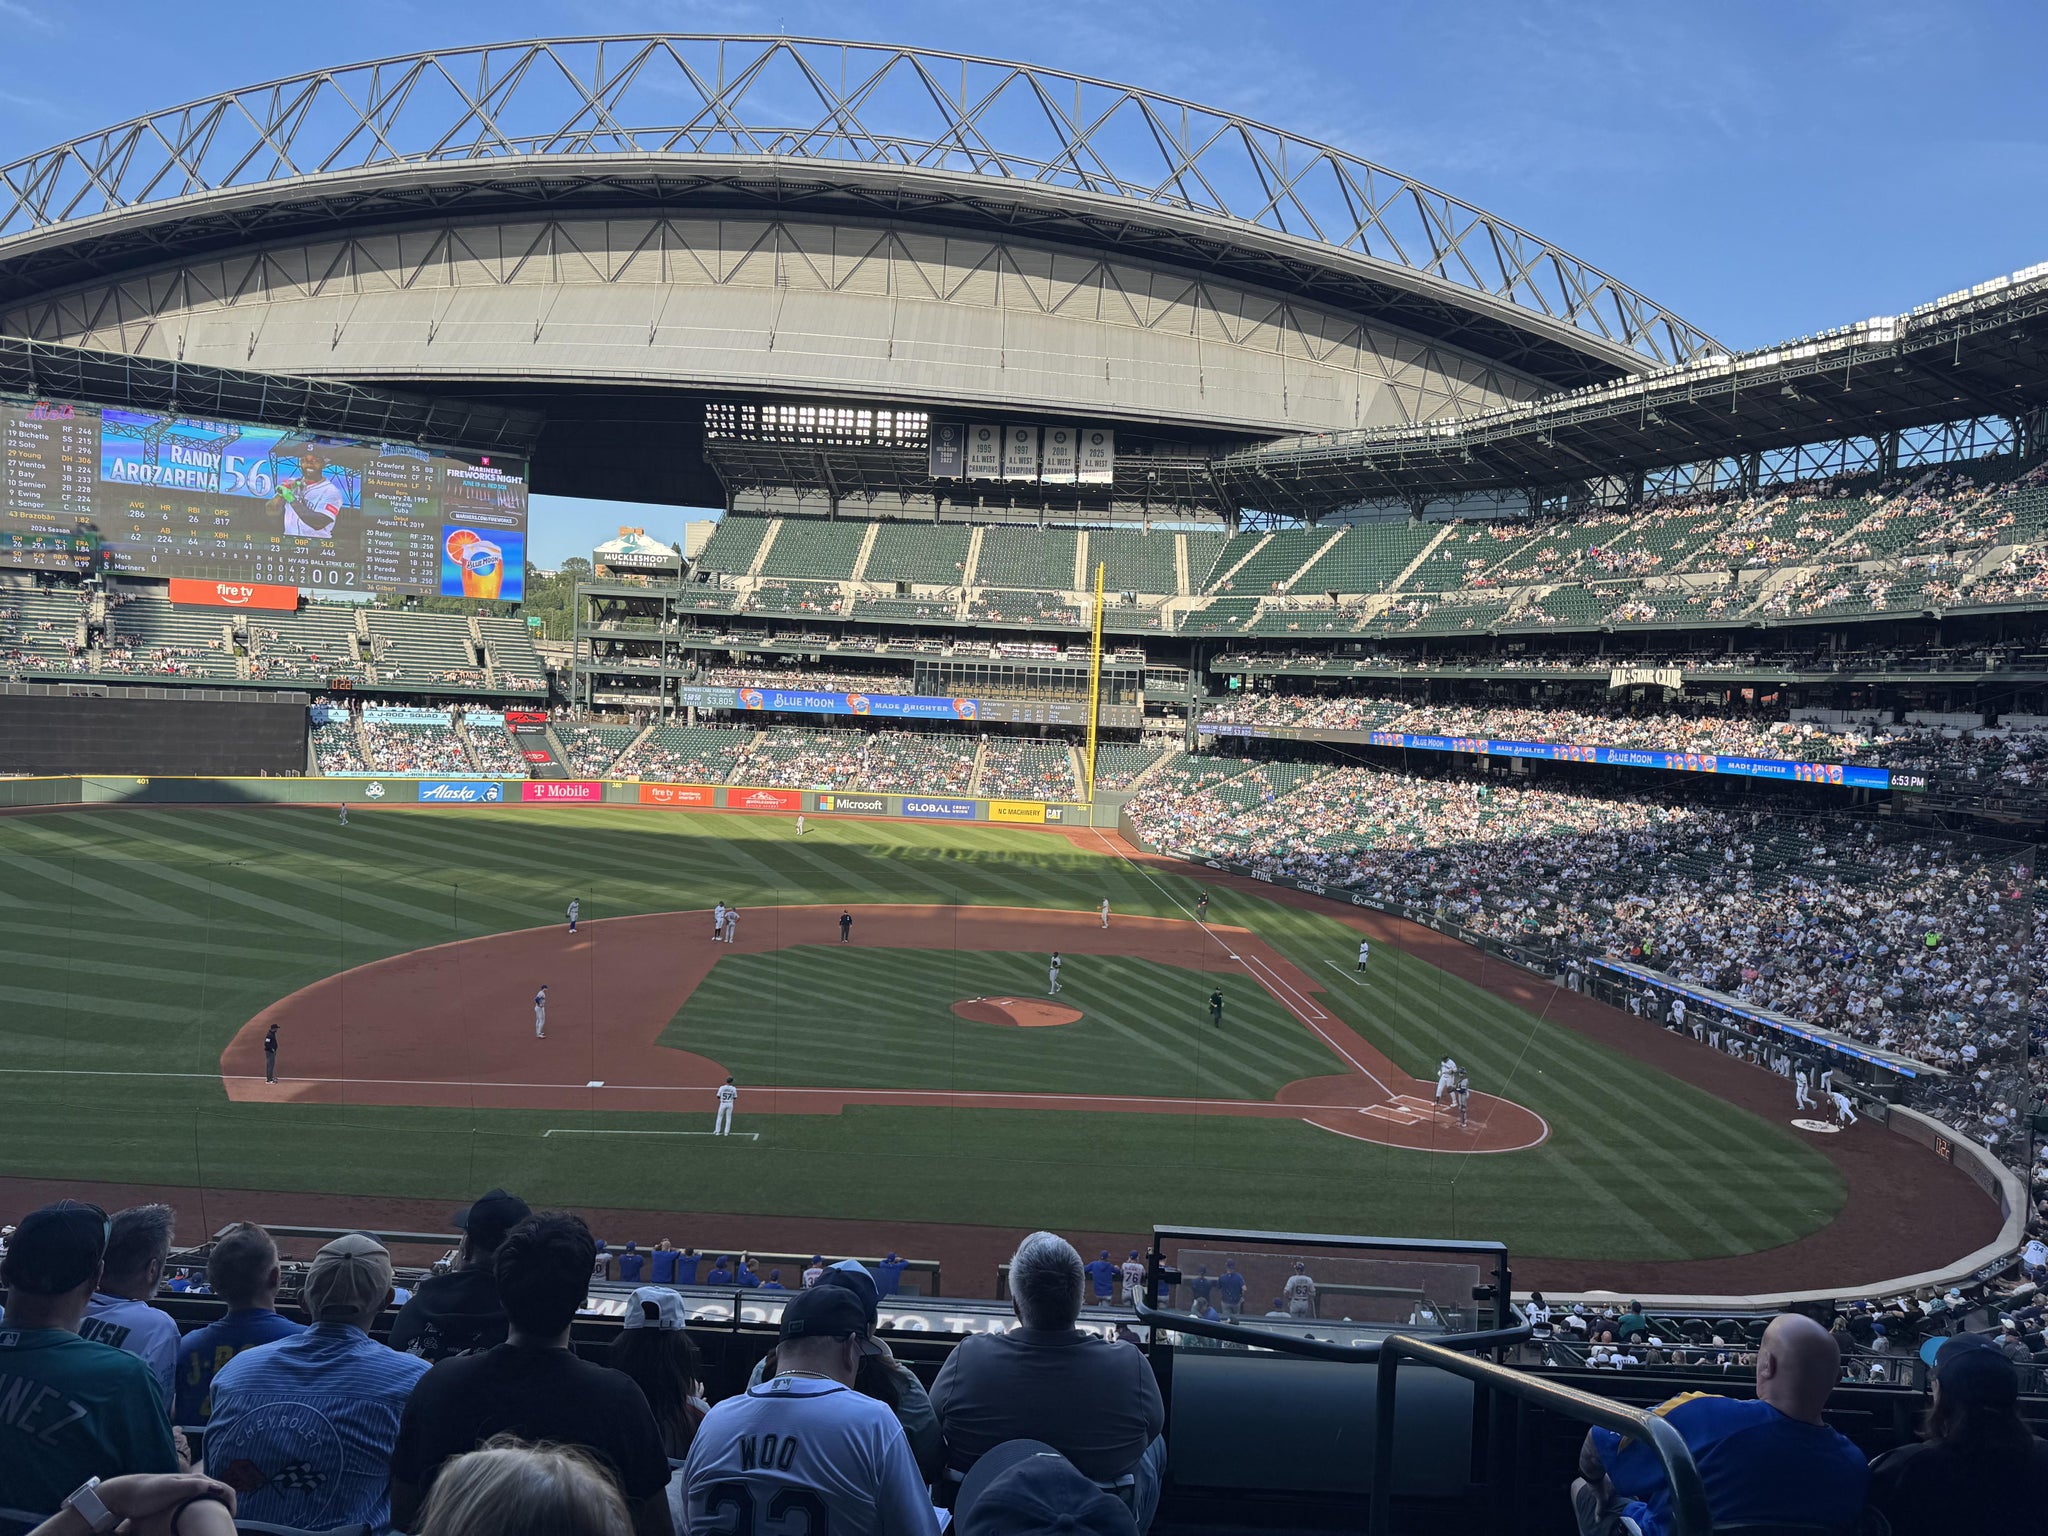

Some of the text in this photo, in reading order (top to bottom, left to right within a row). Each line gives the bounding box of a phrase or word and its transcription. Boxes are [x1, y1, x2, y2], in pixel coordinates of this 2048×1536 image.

[19, 421, 43, 430] Benge
[19, 431, 49, 440] Bichette
[977, 444, 991, 453] 1995
[1014, 445, 1028, 454] 1997
[1052, 447, 1067, 456] 2001
[1090, 448, 1105, 457] 2025
[18, 450, 42, 460] Young
[76, 456, 92, 464] .306
[171, 445, 221, 471] RANDY
[18, 461, 46, 469] Vientos
[377, 462, 405, 470] Crawford
[468, 465, 502, 475] MARINERS
[969, 465, 998, 474] CHAMPIONS
[1006, 466, 1035, 474] CHAMPIONS
[18, 471, 35, 479] Baty
[111, 458, 218, 493] AROZARENA
[224, 455, 272, 497] 56
[446, 469, 523, 485] FIREWORKS NIGHT
[18, 480, 46, 489] Semien
[18, 490, 41, 499] Ewing
[374, 492, 401, 501] February
[18, 500, 45, 509] Senger
[74, 516, 90, 524] 1.82
[128, 510, 145, 518] .286
[189, 515, 199, 523] 26
[377, 519, 398, 527] August
[157, 535, 172, 543] 224
[216, 540, 226, 548] 23
[271, 544, 281, 552] 23
[375, 539, 393, 547] Young
[115, 553, 157, 563] Mets 0
[466, 555, 499, 570] BLUE MOON
[604, 553, 668, 564] MUCKLESHOOT
[114, 563, 146, 572] Mariners
[312, 569, 355, 585] 0 0 2
[374, 574, 401, 582] Emerson
[217, 584, 253, 597] fire tv
[1610, 669, 1682, 689] ALL STAR CLUB
[773, 693, 834, 709] BLUE MOON
[902, 703, 948, 713] BRIGHTER
[1411, 736, 1444, 748] BLUE MOON
[1607, 749, 1652, 764] BLUE MOON
[1728, 763, 1786, 774] MADE BRIGHTER
[1891, 774, 1910, 787] 6:53
[1912, 777, 1924, 788] PM
[370, 784, 380, 793] 50
[423, 784, 475, 800] Alaska
[534, 784, 590, 798] T Mobile
[652, 788, 674, 797] fire tv
[836, 798, 882, 811] Microsoft
[907, 803, 951, 813] GLOBAL
[1007, 808, 1040, 817] MACHINERY
[1046, 809, 1062, 820] CAT
[1251, 870, 1272, 883] STIHL
[1297, 881, 1327, 895] Great Clips
[1360, 899, 1384, 910] LEXUS
[723, 1092, 732, 1100] 57
[2033, 1244, 2044, 1253] 34
[1126, 1271, 1139, 1283] 76
[1295, 1285, 1308, 1295] 63
[1535, 1313, 1547, 1323] 51
[235, 1415, 323, 1449] CHEVROLET
[739, 1433, 799, 1472] WOO
